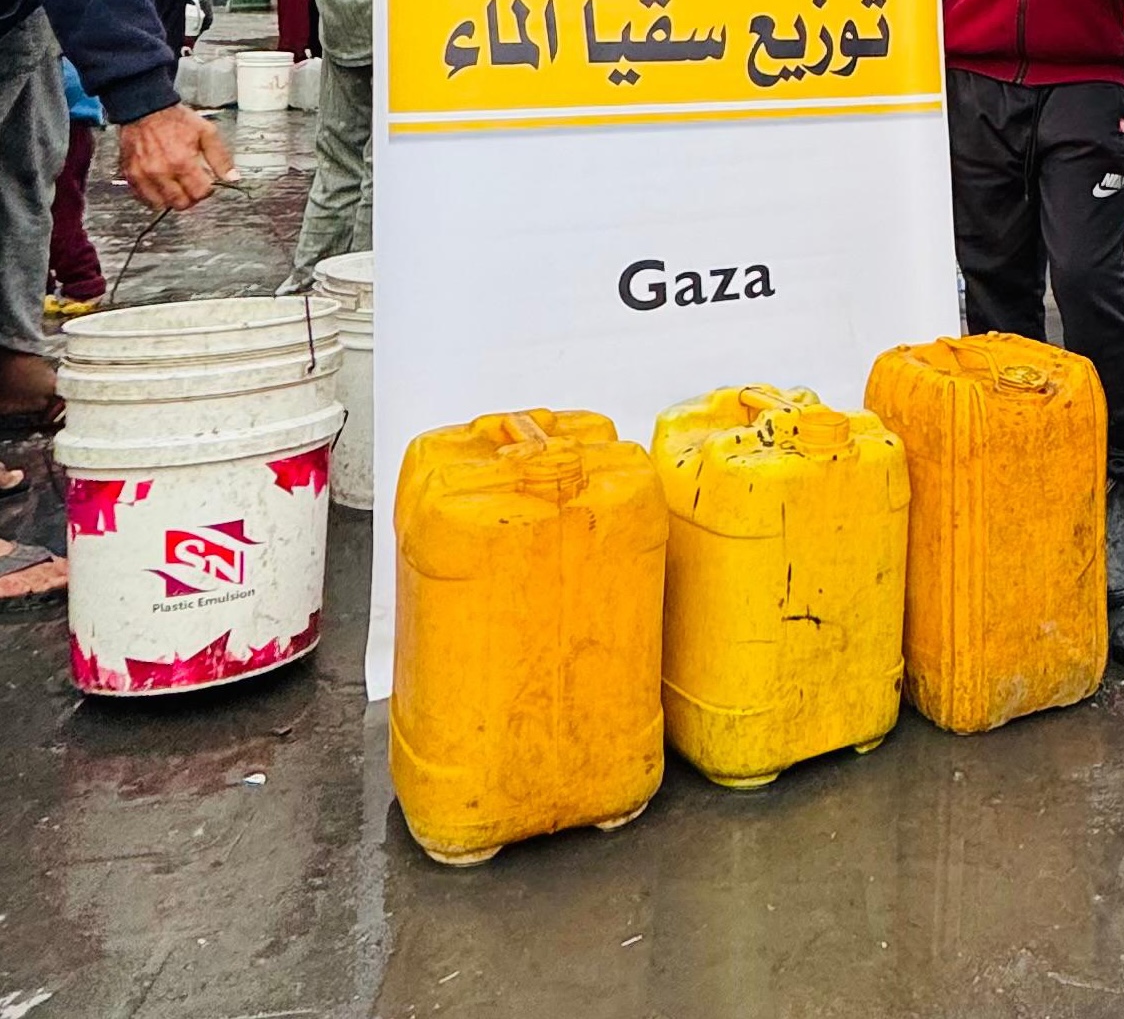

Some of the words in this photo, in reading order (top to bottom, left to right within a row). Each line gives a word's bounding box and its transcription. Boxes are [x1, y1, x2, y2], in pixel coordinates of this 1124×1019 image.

[618, 260, 776, 311] Gaza
[174, 538, 242, 584] SN
[152, 601, 194, 613] Plastic
[198, 589, 255, 607] Emulsion
